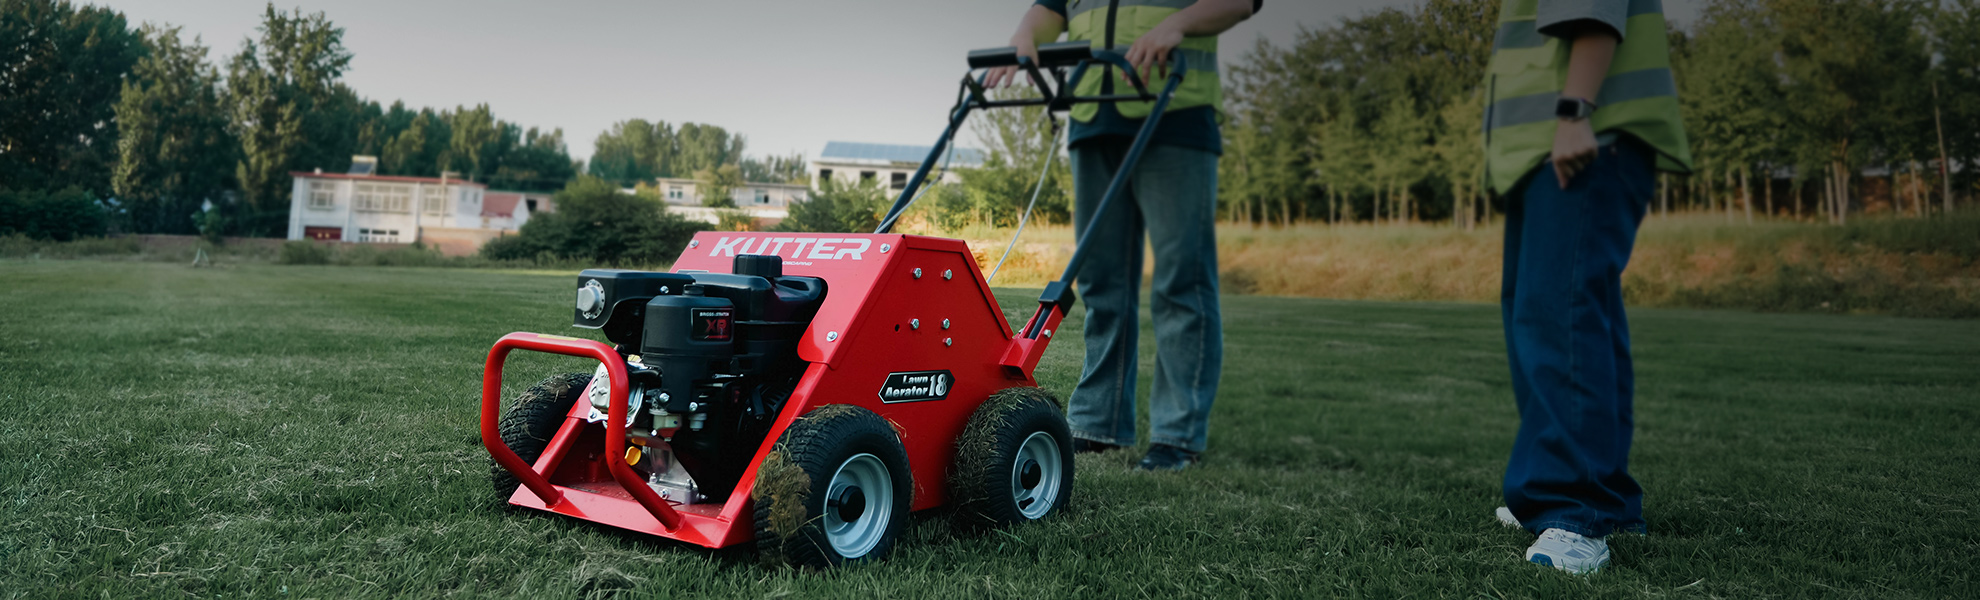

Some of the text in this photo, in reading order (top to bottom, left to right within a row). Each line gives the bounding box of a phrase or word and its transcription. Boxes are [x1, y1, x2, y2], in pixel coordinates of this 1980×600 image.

[709, 237, 872, 260] KUTTER
[705, 319, 727, 332] XR
[885, 386, 928, 397] Aerator
[903, 374, 948, 396] Lawn 18
